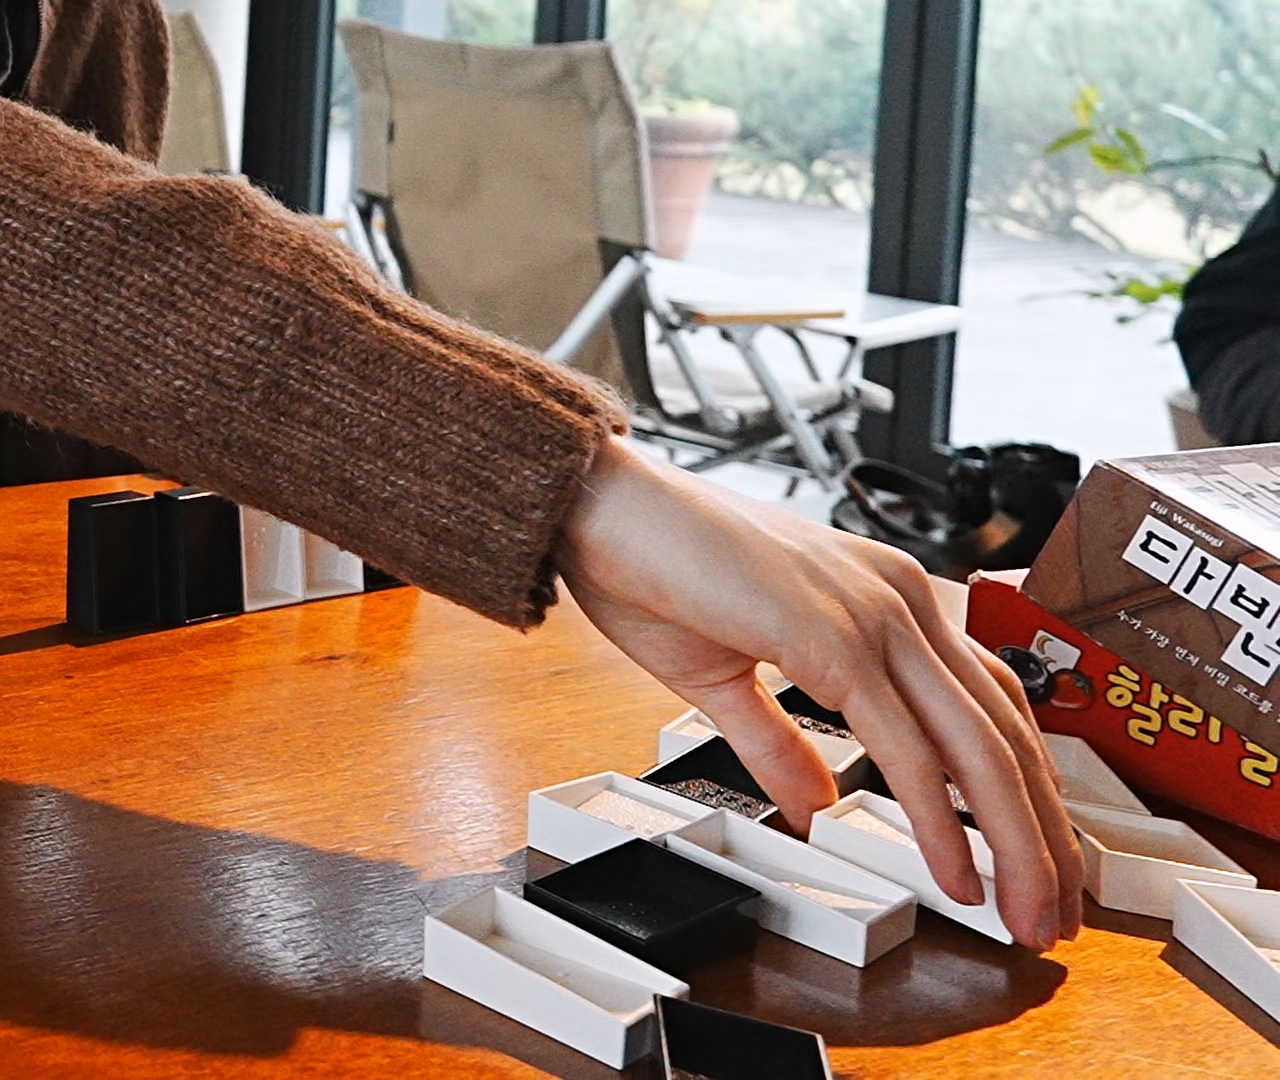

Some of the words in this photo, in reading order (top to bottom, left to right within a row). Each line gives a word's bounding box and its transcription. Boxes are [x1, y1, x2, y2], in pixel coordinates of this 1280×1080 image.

[1172, 512, 1225, 548] Wakasugi
[1116, 609, 1143, 631] 누가
[1144, 627, 1171, 649] 가장
[1175, 645, 1201, 667] 먼저
[1203, 664, 1231, 688] 비밀
[1231, 683, 1274, 714] 코드를
[1104, 663, 1224, 748] 할리
